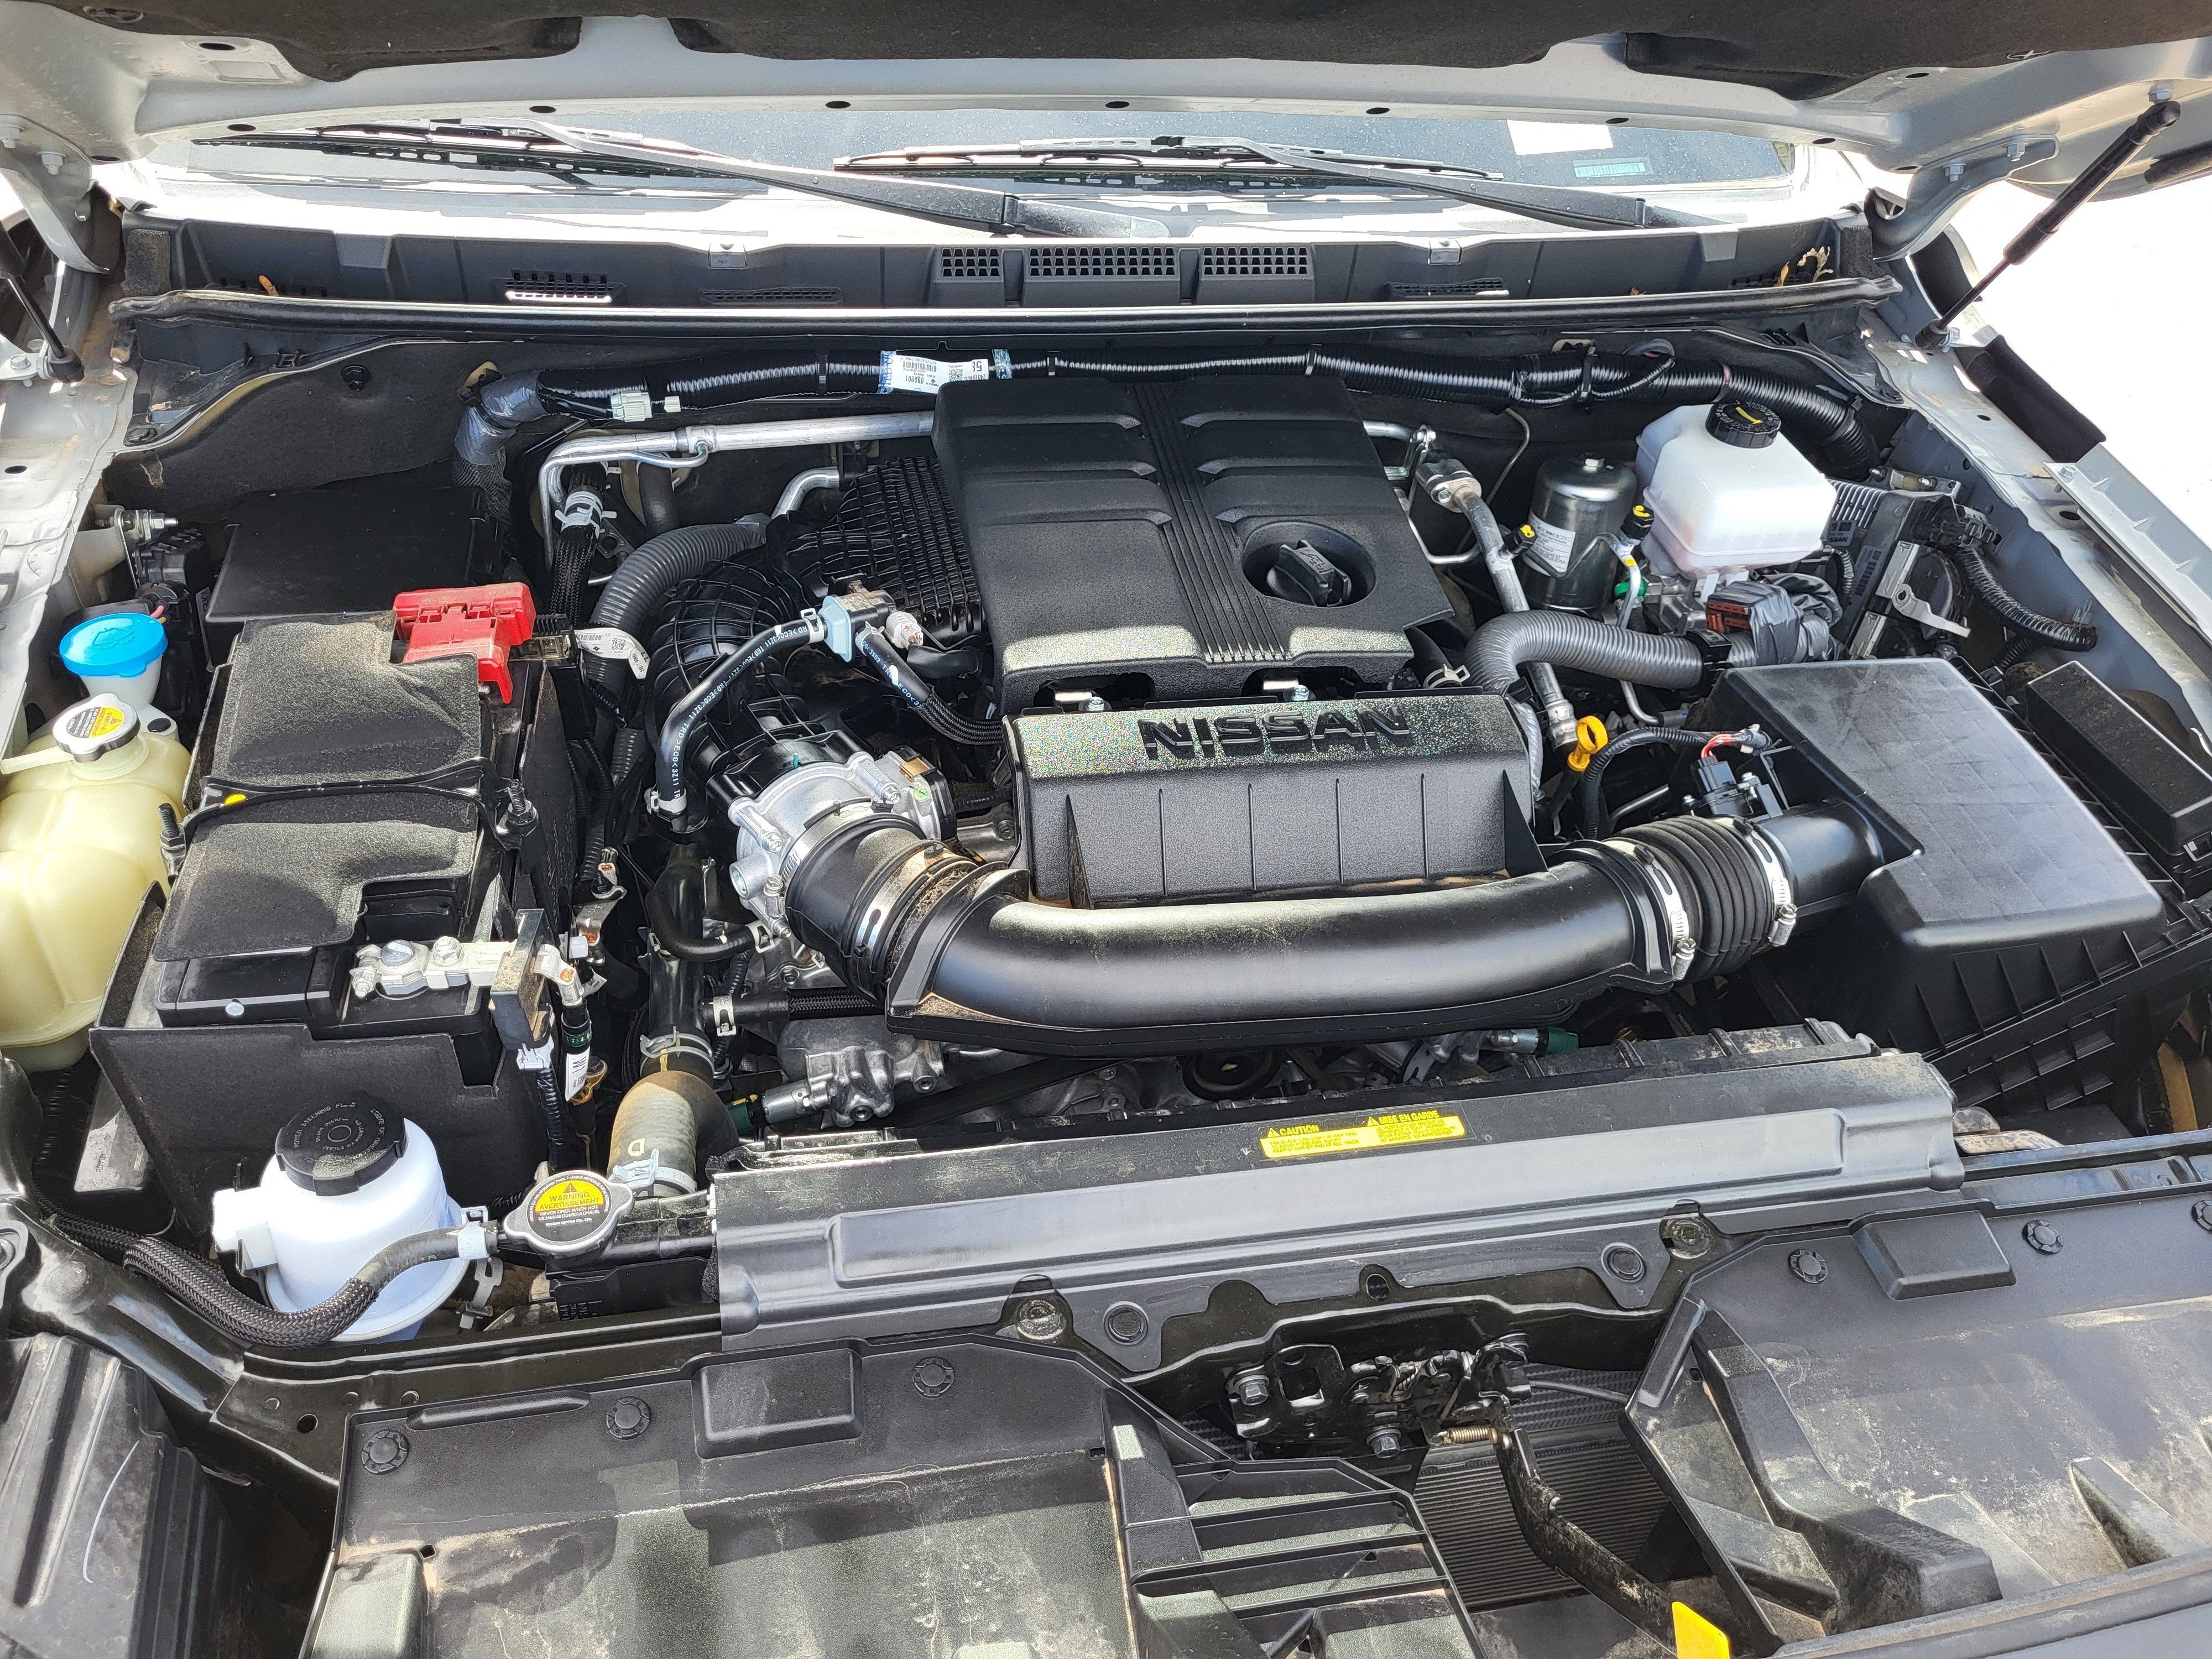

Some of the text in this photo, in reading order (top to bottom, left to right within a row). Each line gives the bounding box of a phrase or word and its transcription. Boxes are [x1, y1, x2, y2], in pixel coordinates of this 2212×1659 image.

[764, 625, 807, 647] RD>ECO<3Z11
[1138, 706, 1410, 747] NISSAN
[1379, 1110, 1439, 1125] MISE EN GARDE
[1279, 1124, 1319, 1136] CAUTION
[539, 1197, 600, 1210] AVERTISSEMENT
[549, 1191, 590, 1202] WARNING
